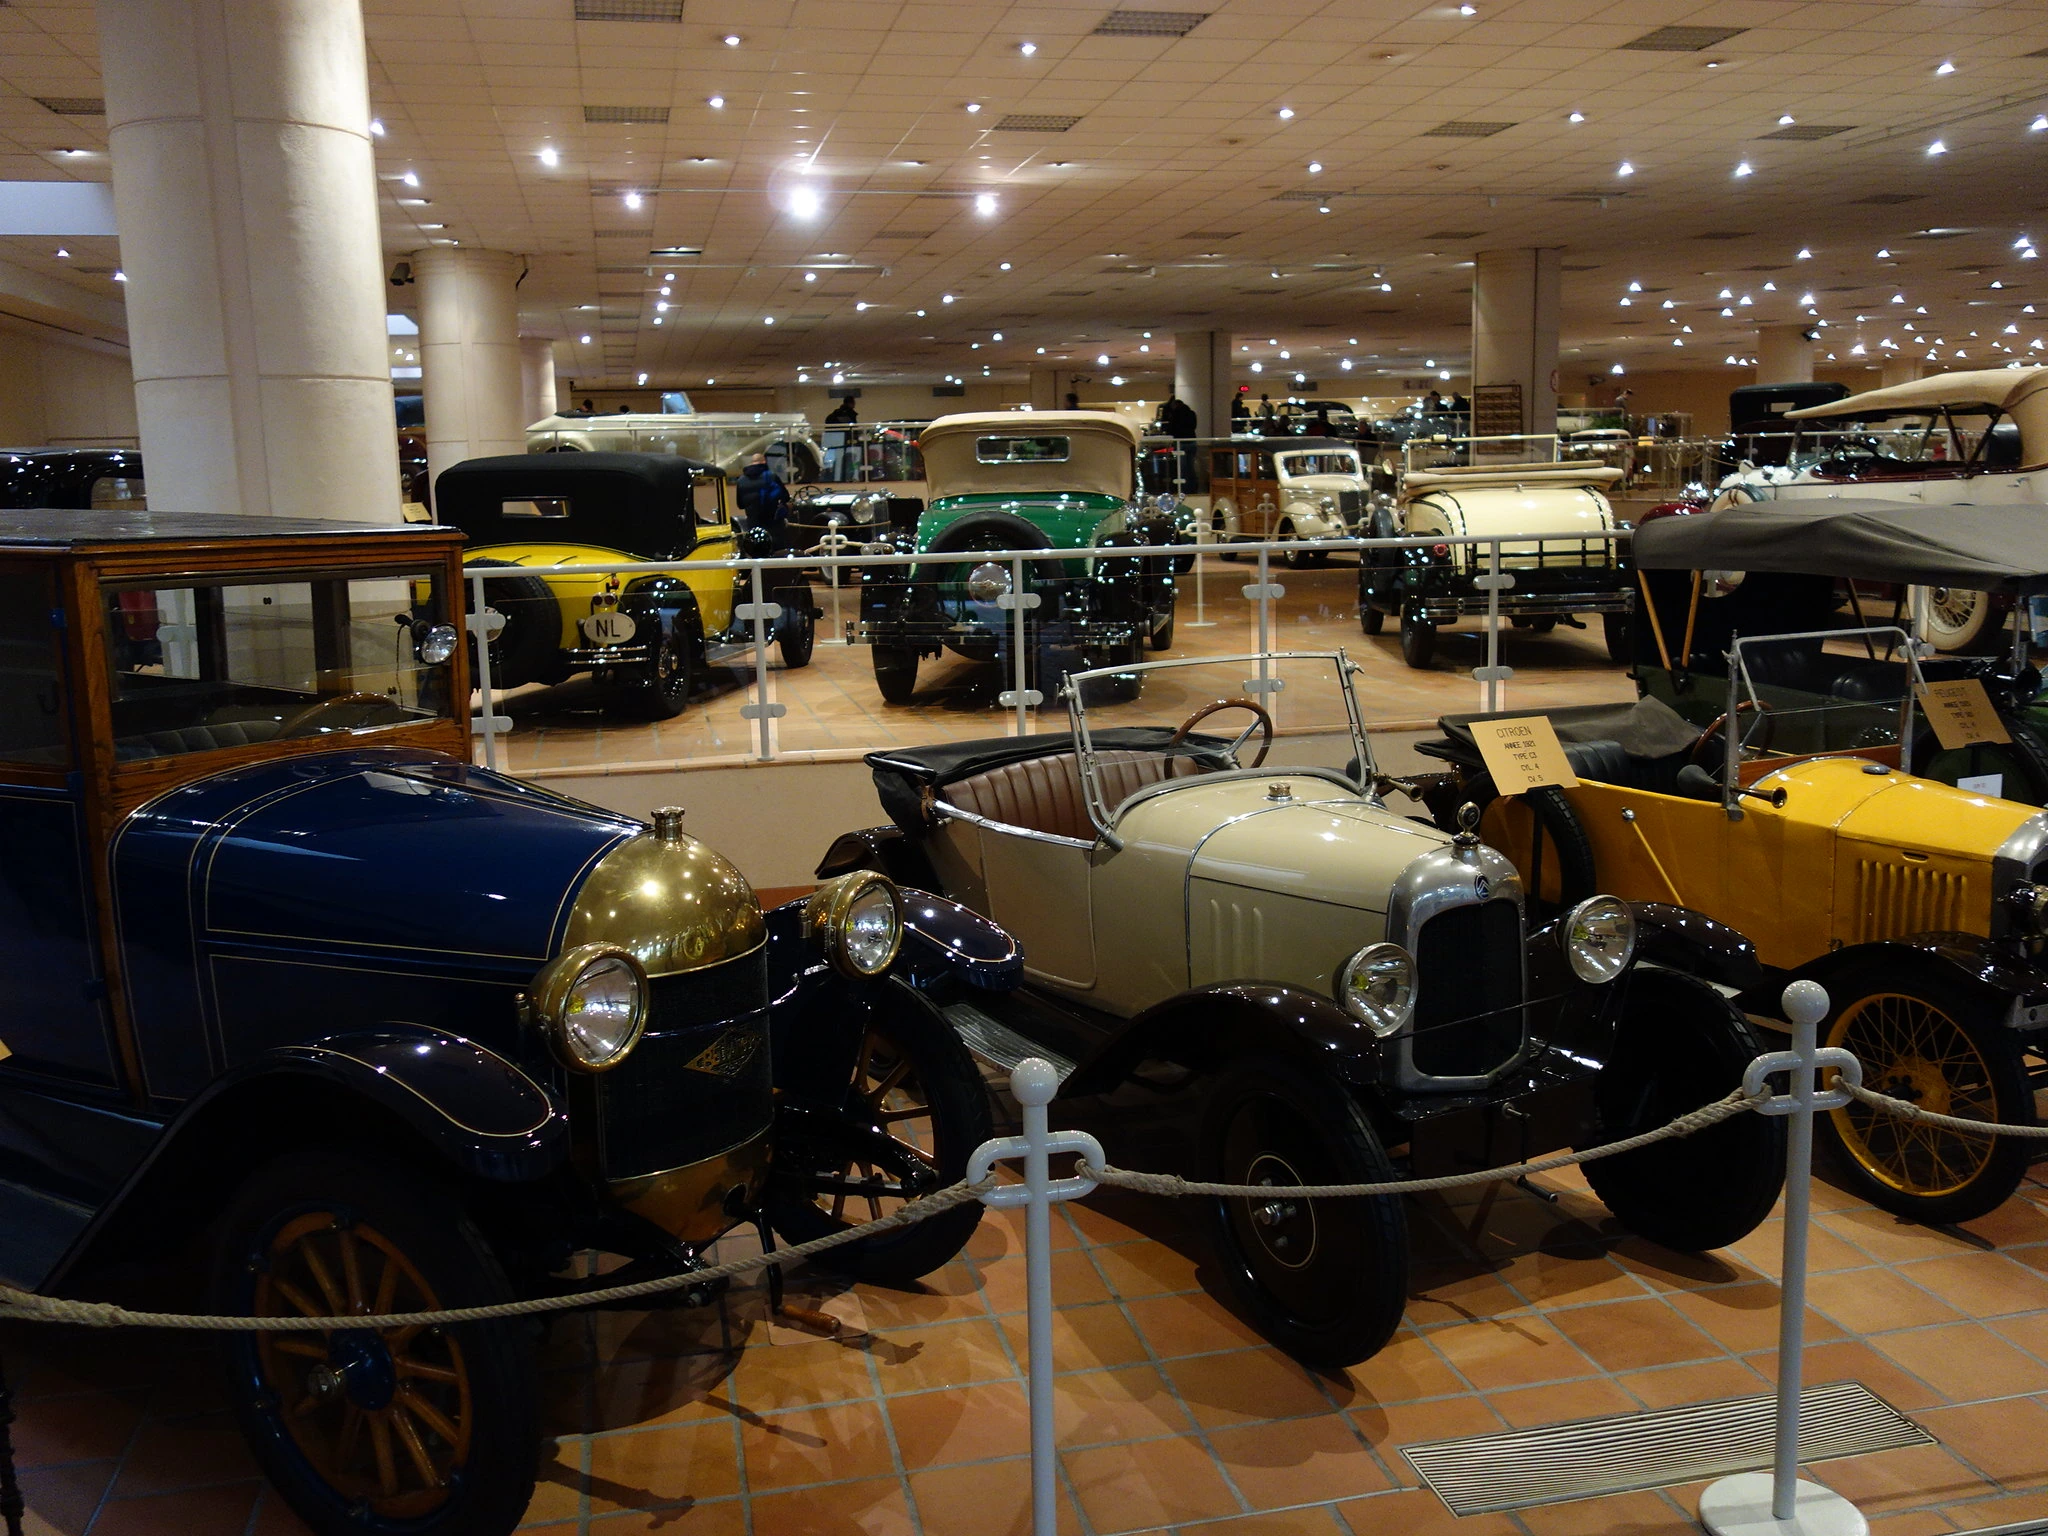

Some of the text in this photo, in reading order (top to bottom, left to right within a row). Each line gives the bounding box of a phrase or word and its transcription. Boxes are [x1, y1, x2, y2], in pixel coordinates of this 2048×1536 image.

[596, 619, 621, 637] NL
[1496, 726, 1532, 738] CITROEN
[1513, 752, 1527, 760] TYPE
[1538, 774, 1544, 782] 5
